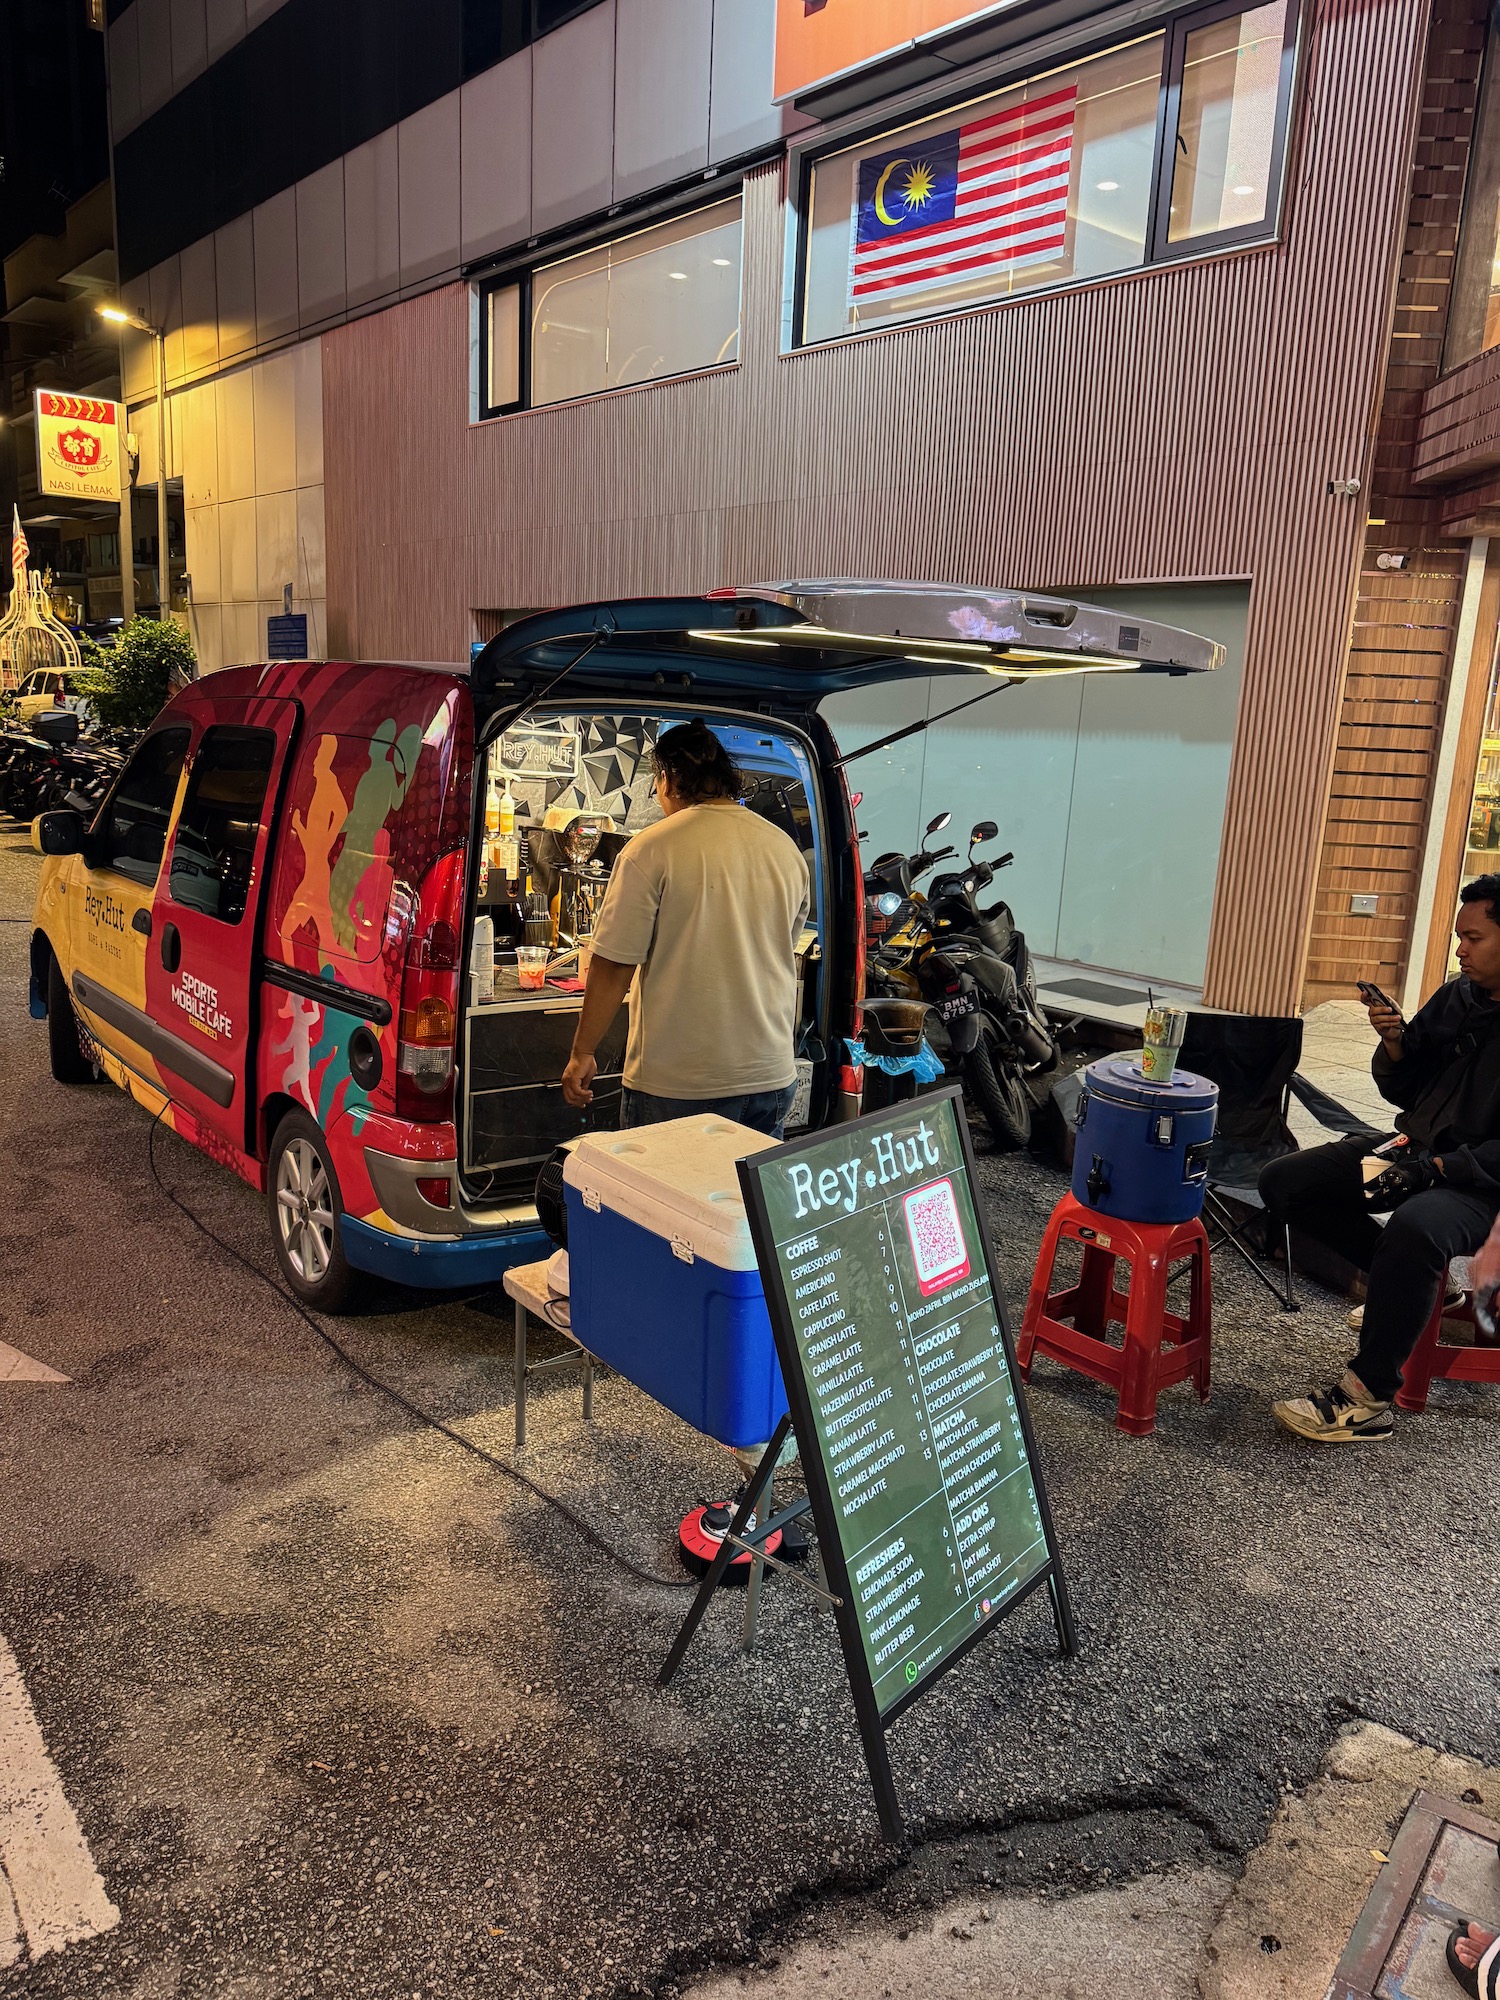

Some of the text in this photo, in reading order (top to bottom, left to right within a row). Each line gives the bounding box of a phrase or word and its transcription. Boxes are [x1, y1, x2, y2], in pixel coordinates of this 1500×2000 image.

[49, 480, 113, 496] NASI LEMAK
[503, 741, 573, 764] REY.HUT
[85, 885, 125, 932] Rey.Hut
[182, 971, 218, 1008] SPORTS
[942, 1002, 974, 1020] 8783
[944, 995, 968, 1011] BMN
[788, 1119, 939, 1219] Rey.Hut
[786, 1235, 820, 1260] COFFEE
[791, 1230, 884, 1281] ESPRESSO SHOT 6
[795, 1246, 886, 1300] AMERICANO 7
[799, 1265, 890, 1319] CAFFE LATTE 9
[803, 1284, 894, 1338] CAPPUCCINO 9
[907, 1307, 925, 1324] MOHD
[924, 1298, 943, 1315] ZAFRIL
[942, 1293, 953, 1305] BIN
[951, 1285, 969, 1300] MOHD
[808, 1301, 898, 1358] SPANISH LATTE 10
[812, 1320, 903, 1377] CARAMEL LATTE 11
[915, 1322, 961, 1357] CHOCOLATE
[920, 1325, 999, 1376] CHOCOLATE 10
[816, 1338, 907, 1397] VANILLA LATTE 11
[821, 1356, 911, 1417] HAZELNUT LATTE 11
[924, 1342, 1003, 1396] CHOCOLATE STRAWBERRY 12
[928, 1359, 1006, 1413] CHOCOLATE BANANA 12
[825, 1374, 914, 1437] BUTTERSCOTCH LATTE 11
[829, 1393, 919, 1458] BANANA LATTE 11
[933, 1408, 966, 1439] MATCHA
[936, 1394, 1015, 1453] MATCHA LATTE 12
[833, 1410, 923, 1478] STRAWBERRY LATTE 11
[838, 1429, 928, 1498] CARAMEL MACCHIATO 13
[941, 1412, 1018, 1470] MATCHA STRAWBERRY 14
[945, 1429, 1022, 1489] MATCHA CHOCOLATE 14
[843, 1447, 932, 1517] MOCHA LATTE 13
[949, 1448, 1026, 1510] MATCHA BANANA 14
[955, 1501, 989, 1536] ADD ONS
[959, 1488, 1034, 1552] EXTRA SYRUP 2
[963, 1504, 1038, 1570] OAT MILK 3
[856, 1537, 906, 1585] REFRESHERS
[861, 1527, 948, 1603] LEMONADE SODA 6
[967, 1520, 1041, 1588] EXTRA SHOT 2
[865, 1546, 952, 1623] STRAWBERRY SODA 6
[870, 1563, 956, 1644] PINK LEMONADE 7
[874, 1584, 962, 1665] BUTTER BEER 11
